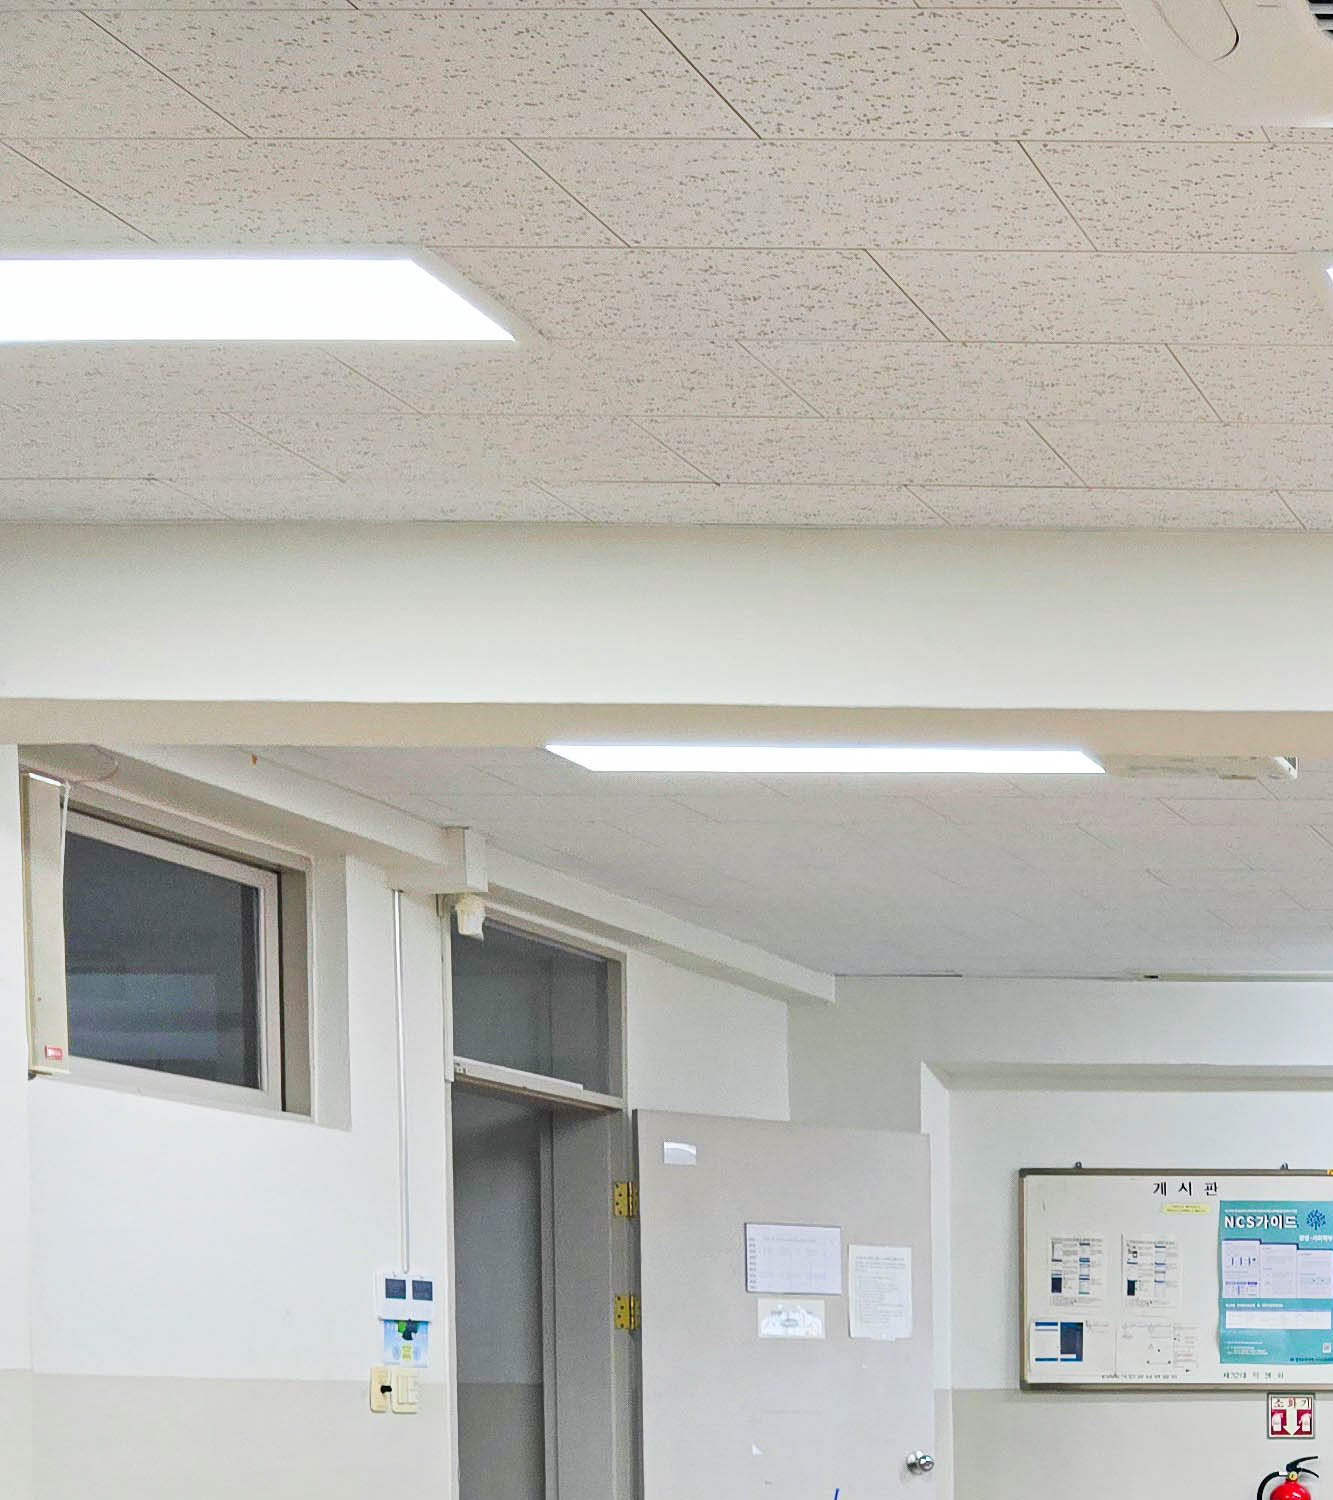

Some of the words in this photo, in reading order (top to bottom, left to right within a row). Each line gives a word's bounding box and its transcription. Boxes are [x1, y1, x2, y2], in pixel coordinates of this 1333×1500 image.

[1153, 1181, 1218, 1197] 게시판
[1225, 1215, 1297, 1230] NCS가이드
[1272, 1398, 1312, 1410] 소화기
